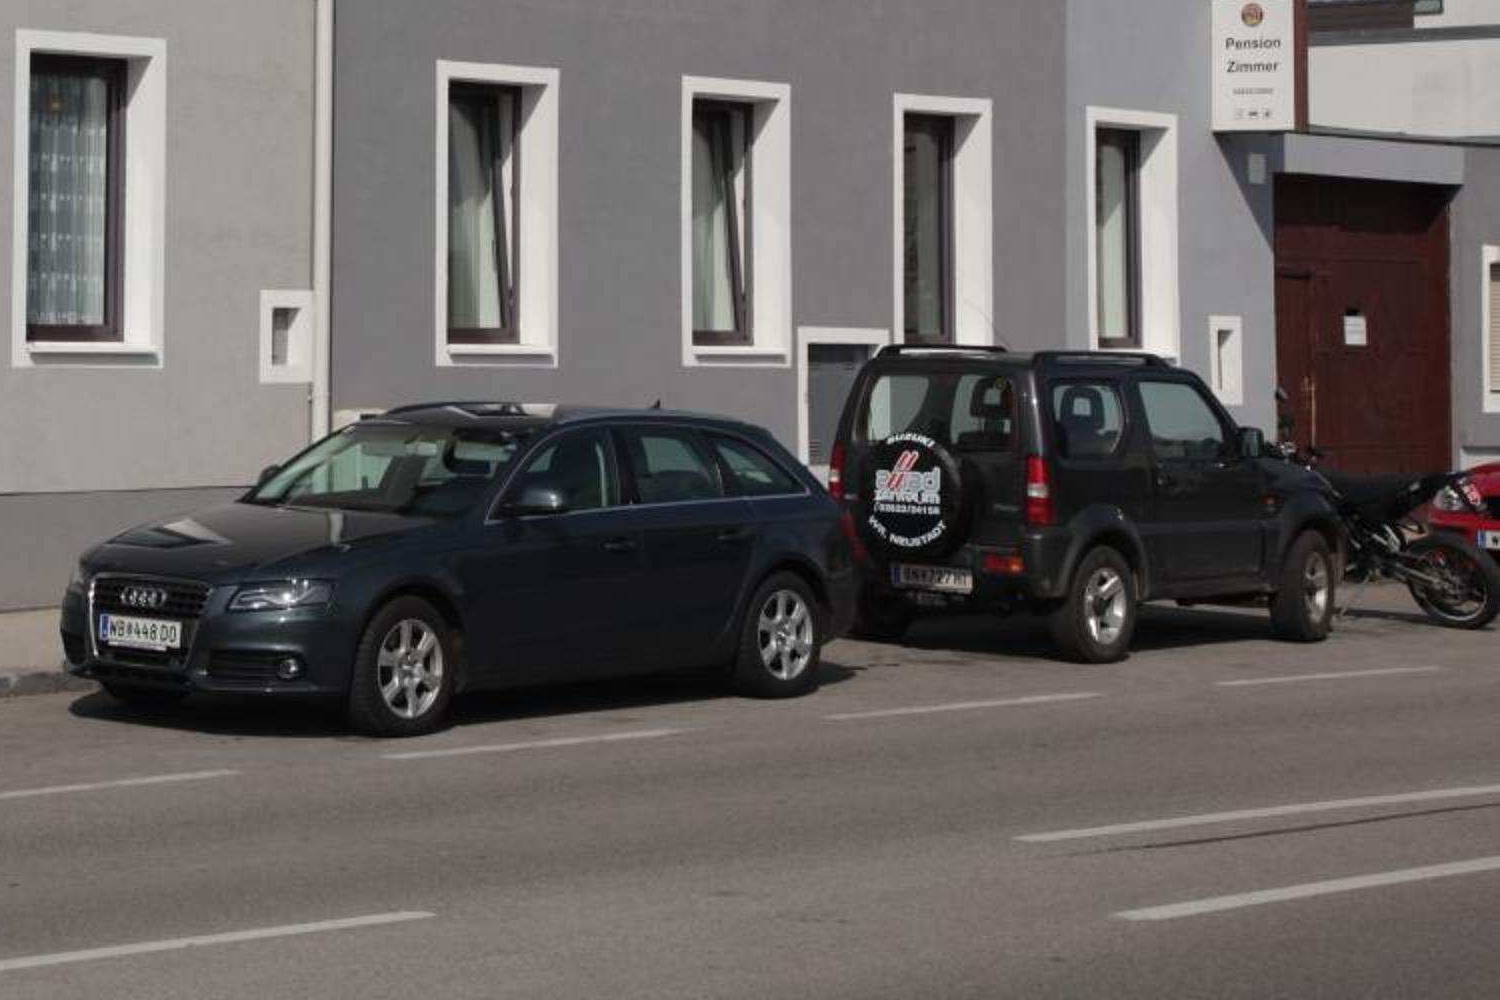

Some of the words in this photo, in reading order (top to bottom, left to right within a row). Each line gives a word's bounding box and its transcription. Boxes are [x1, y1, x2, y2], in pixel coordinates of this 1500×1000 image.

[1225, 37, 1281, 50] Pension
[1226, 60, 1279, 73] Zimmer
[886, 433, 936, 448] SUZUKI
[889, 521, 947, 547] NEUSTADT
